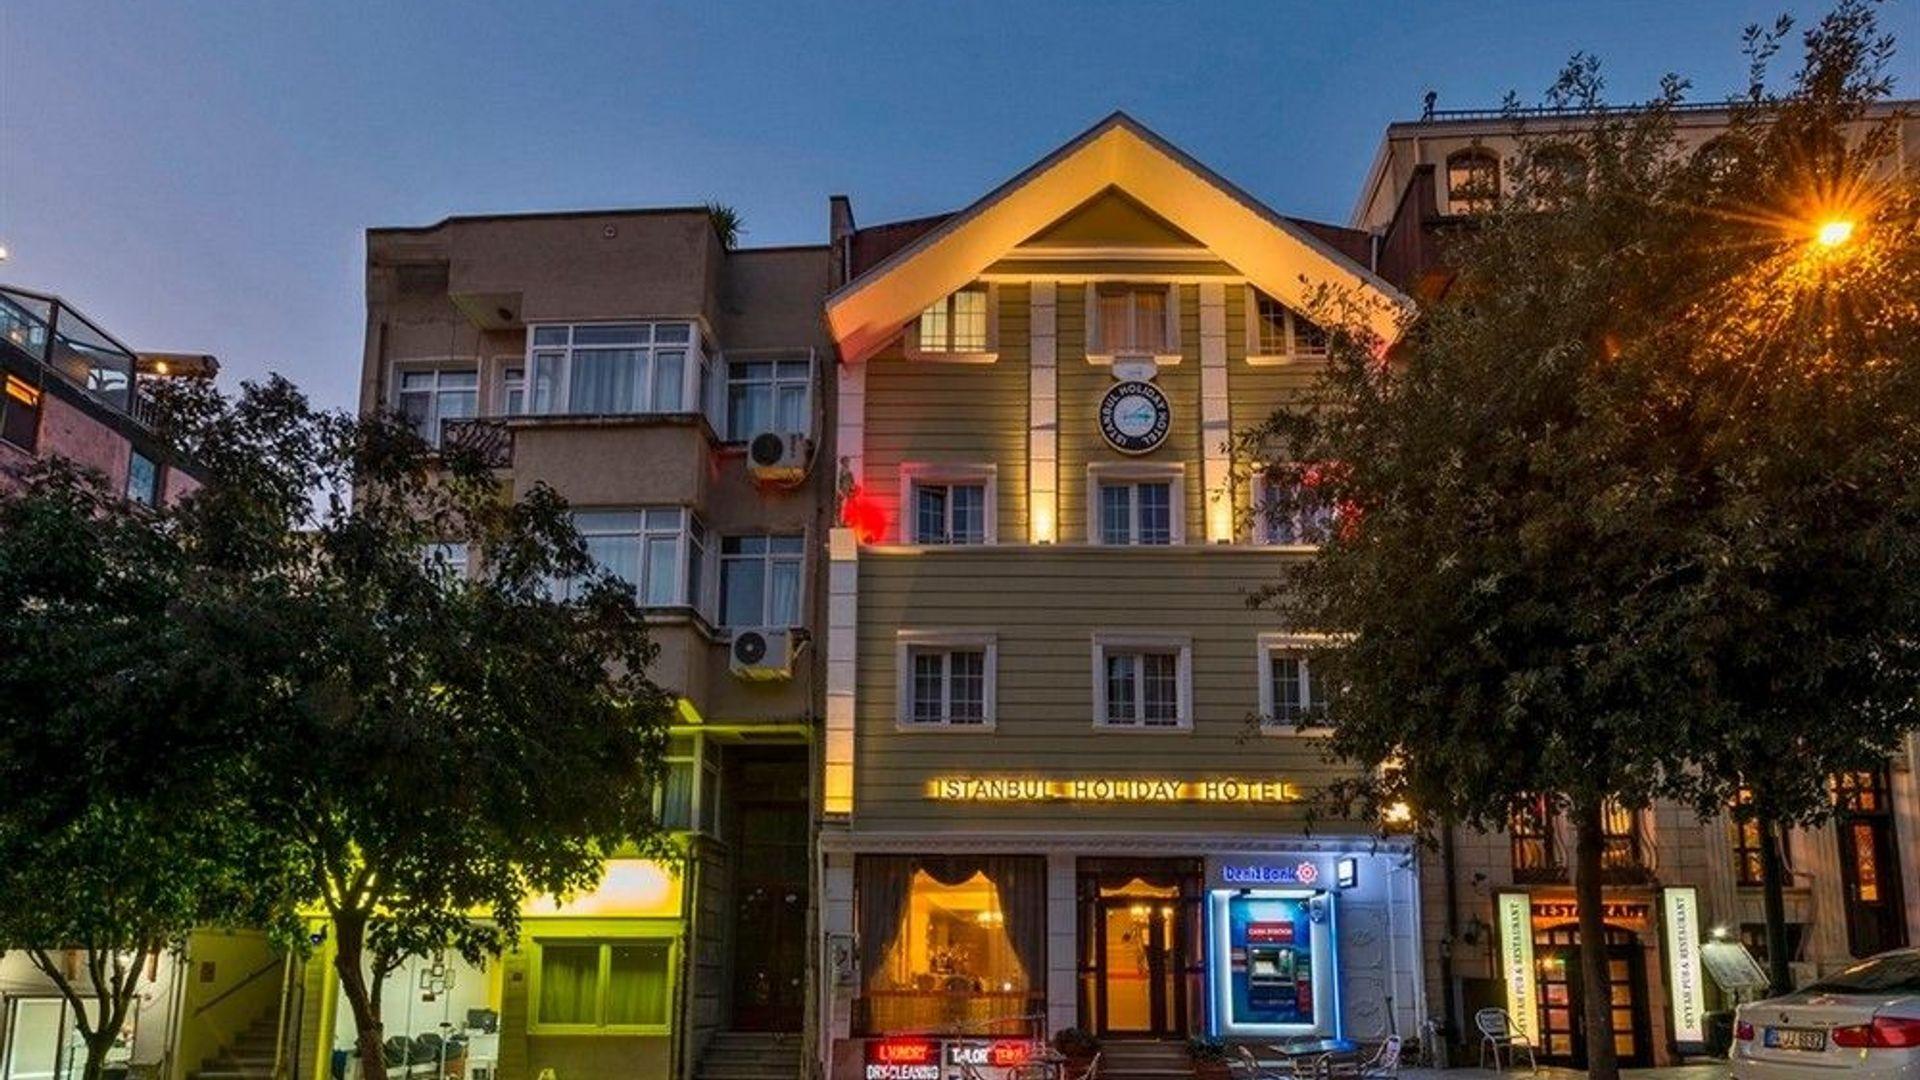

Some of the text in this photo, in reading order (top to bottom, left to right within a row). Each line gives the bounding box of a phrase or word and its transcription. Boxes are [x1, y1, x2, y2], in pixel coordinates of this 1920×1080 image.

[1119, 383, 1167, 409] HOLIDAY
[1140, 411, 1168, 445] HOTEL
[936, 779, 1301, 801] ISTANBUL HOLIDAY HOTEL
[1532, 903, 1648, 918] RESTRANT
[1676, 897, 1689, 959] RESTAURANT
[1514, 977, 1525, 995] PUB
[1681, 971, 1691, 989] PUB
